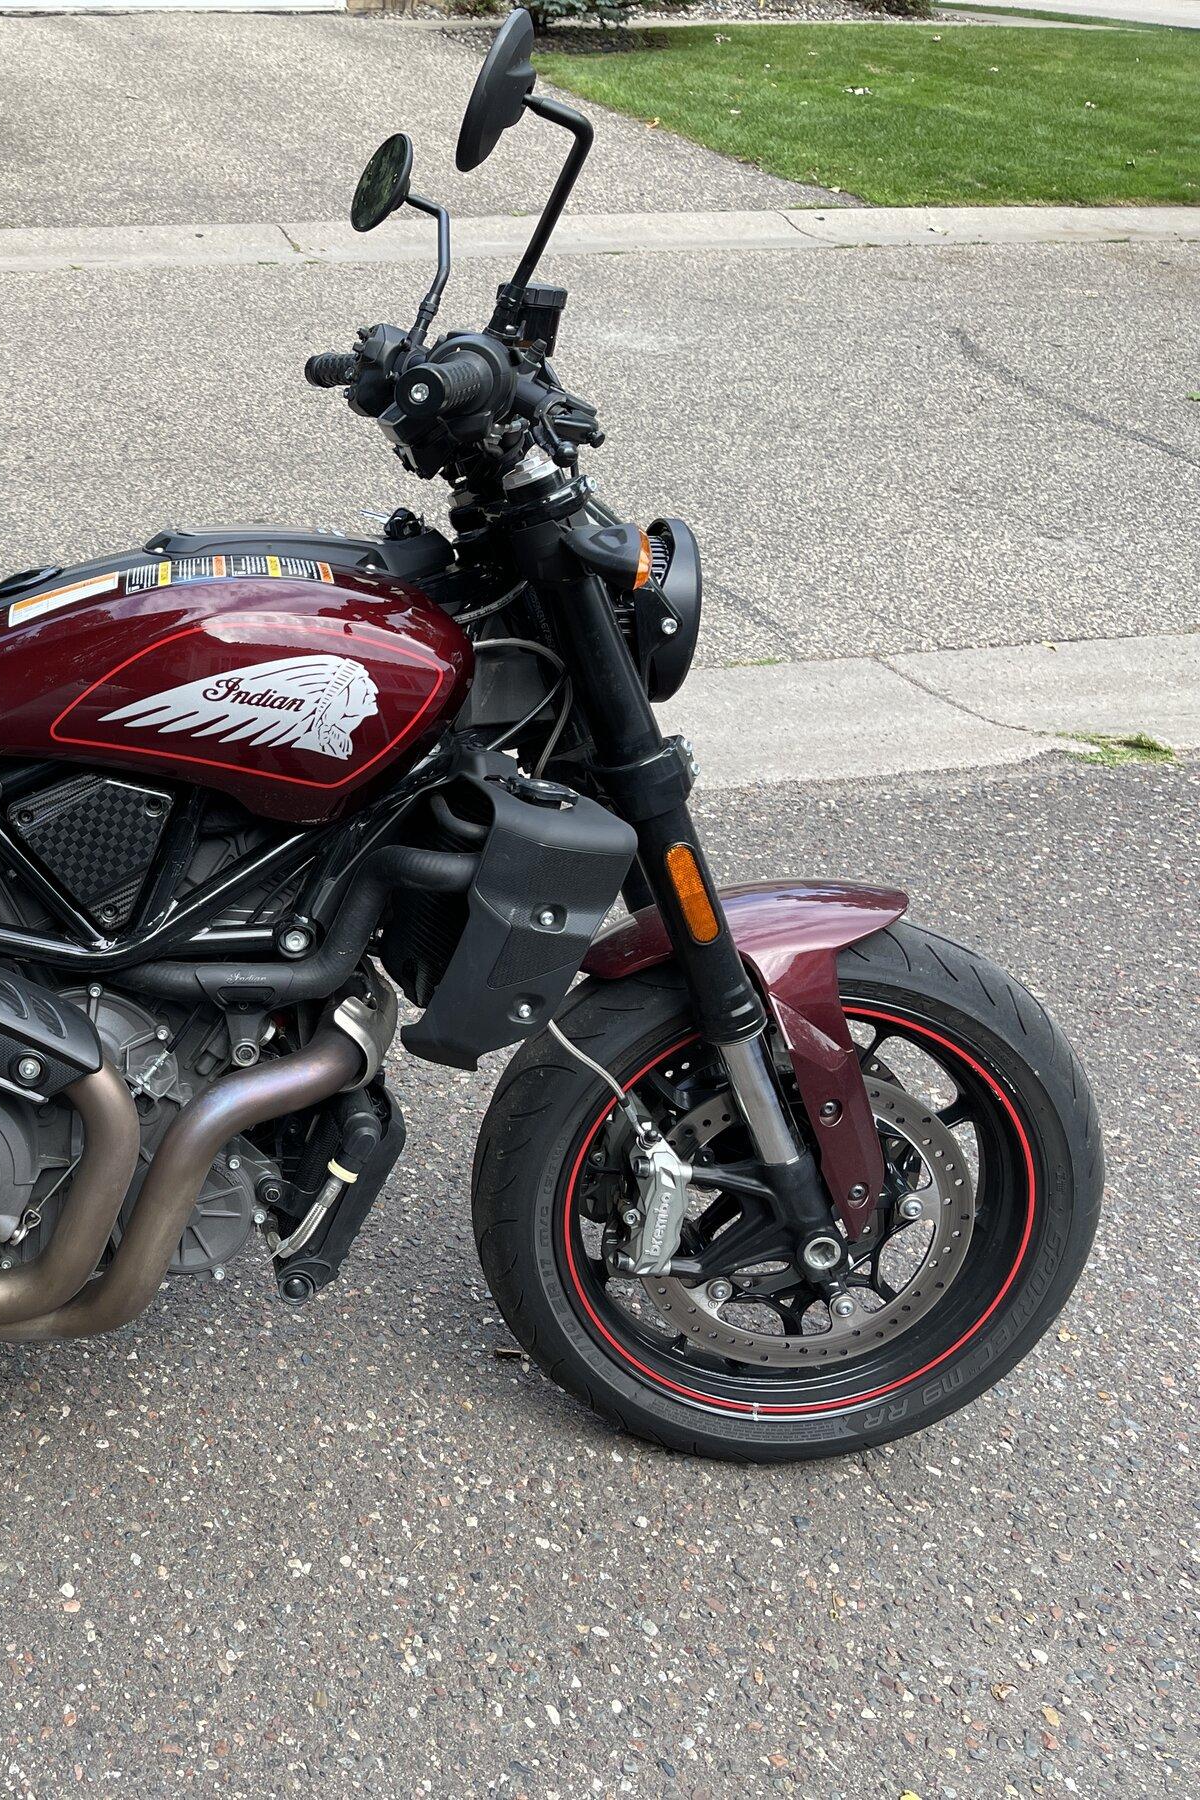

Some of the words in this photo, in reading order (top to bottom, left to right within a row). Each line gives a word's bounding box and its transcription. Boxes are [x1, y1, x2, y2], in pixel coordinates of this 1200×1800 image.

[203, 677, 305, 712] Indian
[647, 1192, 671, 1256] brembo
[864, 1401, 908, 1428] RR
